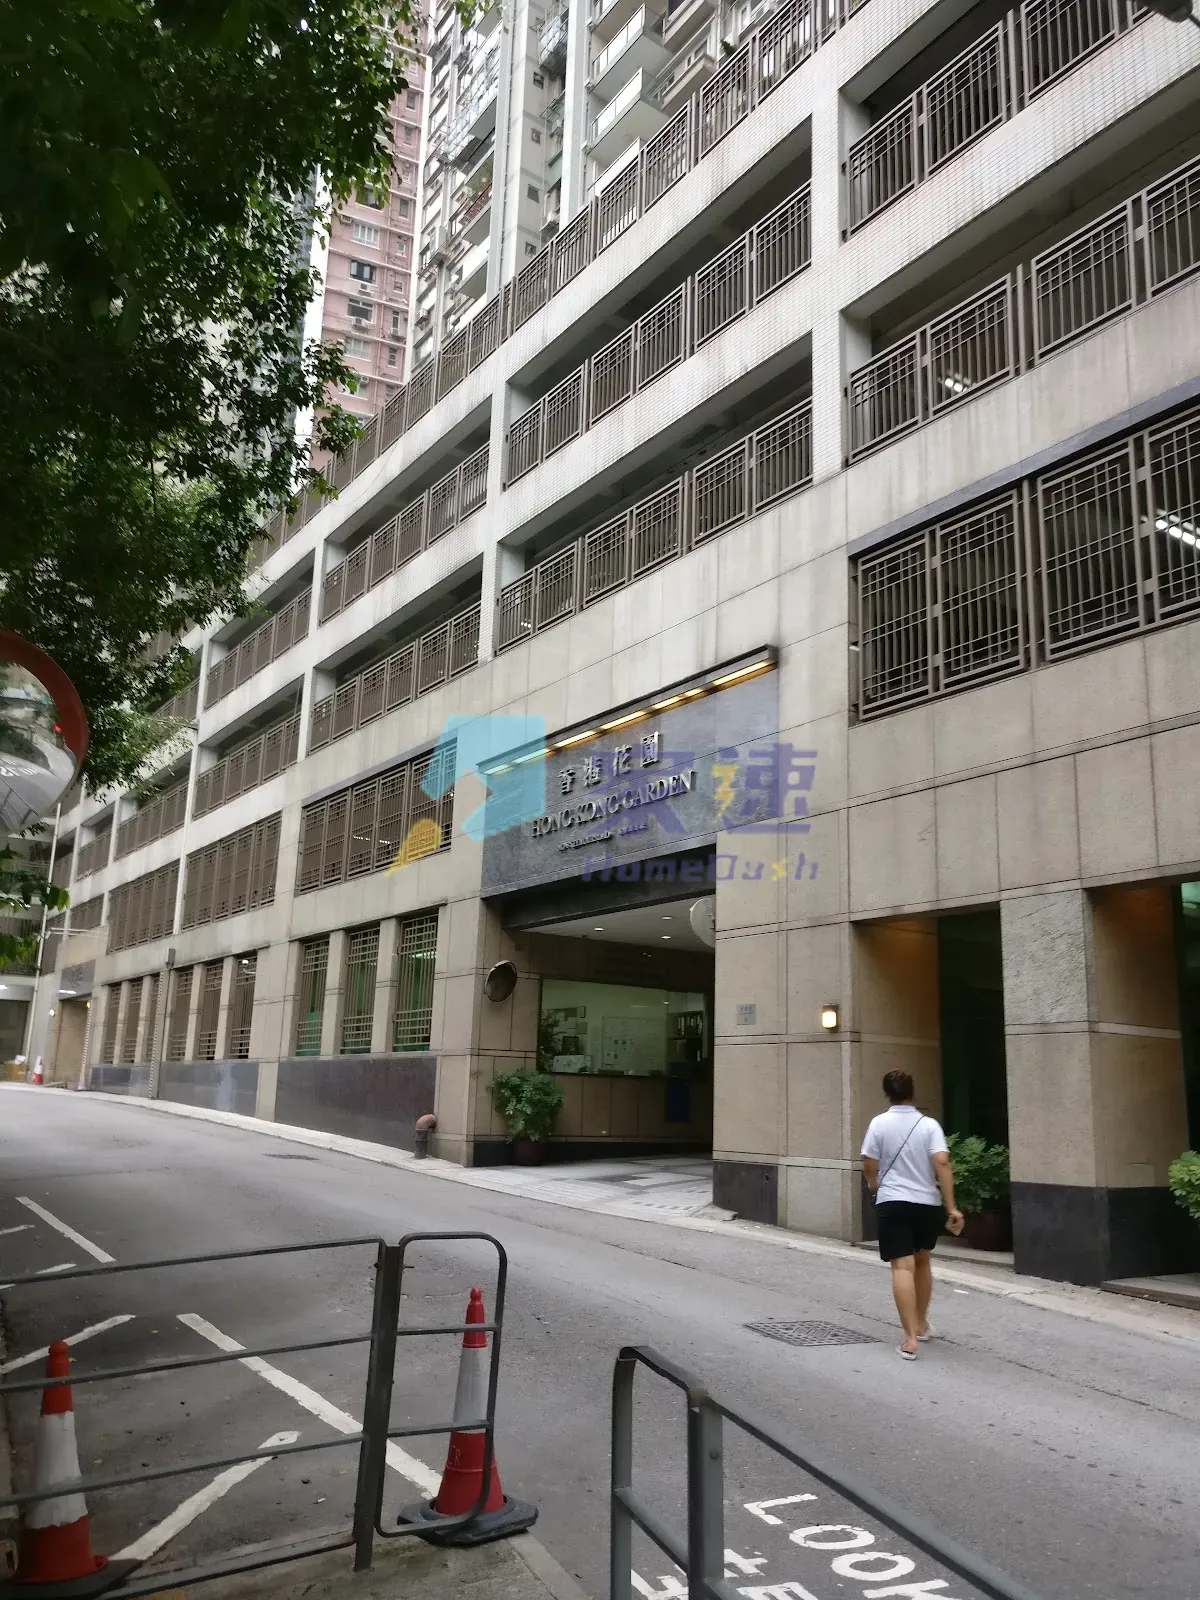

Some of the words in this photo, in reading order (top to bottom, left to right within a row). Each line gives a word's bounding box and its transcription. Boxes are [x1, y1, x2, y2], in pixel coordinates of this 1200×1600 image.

[557, 731, 661, 796] 香港花園
[531, 807, 574, 837] HONG
[574, 794, 621, 824] KONG
[621, 769, 696, 810] GARDEN
